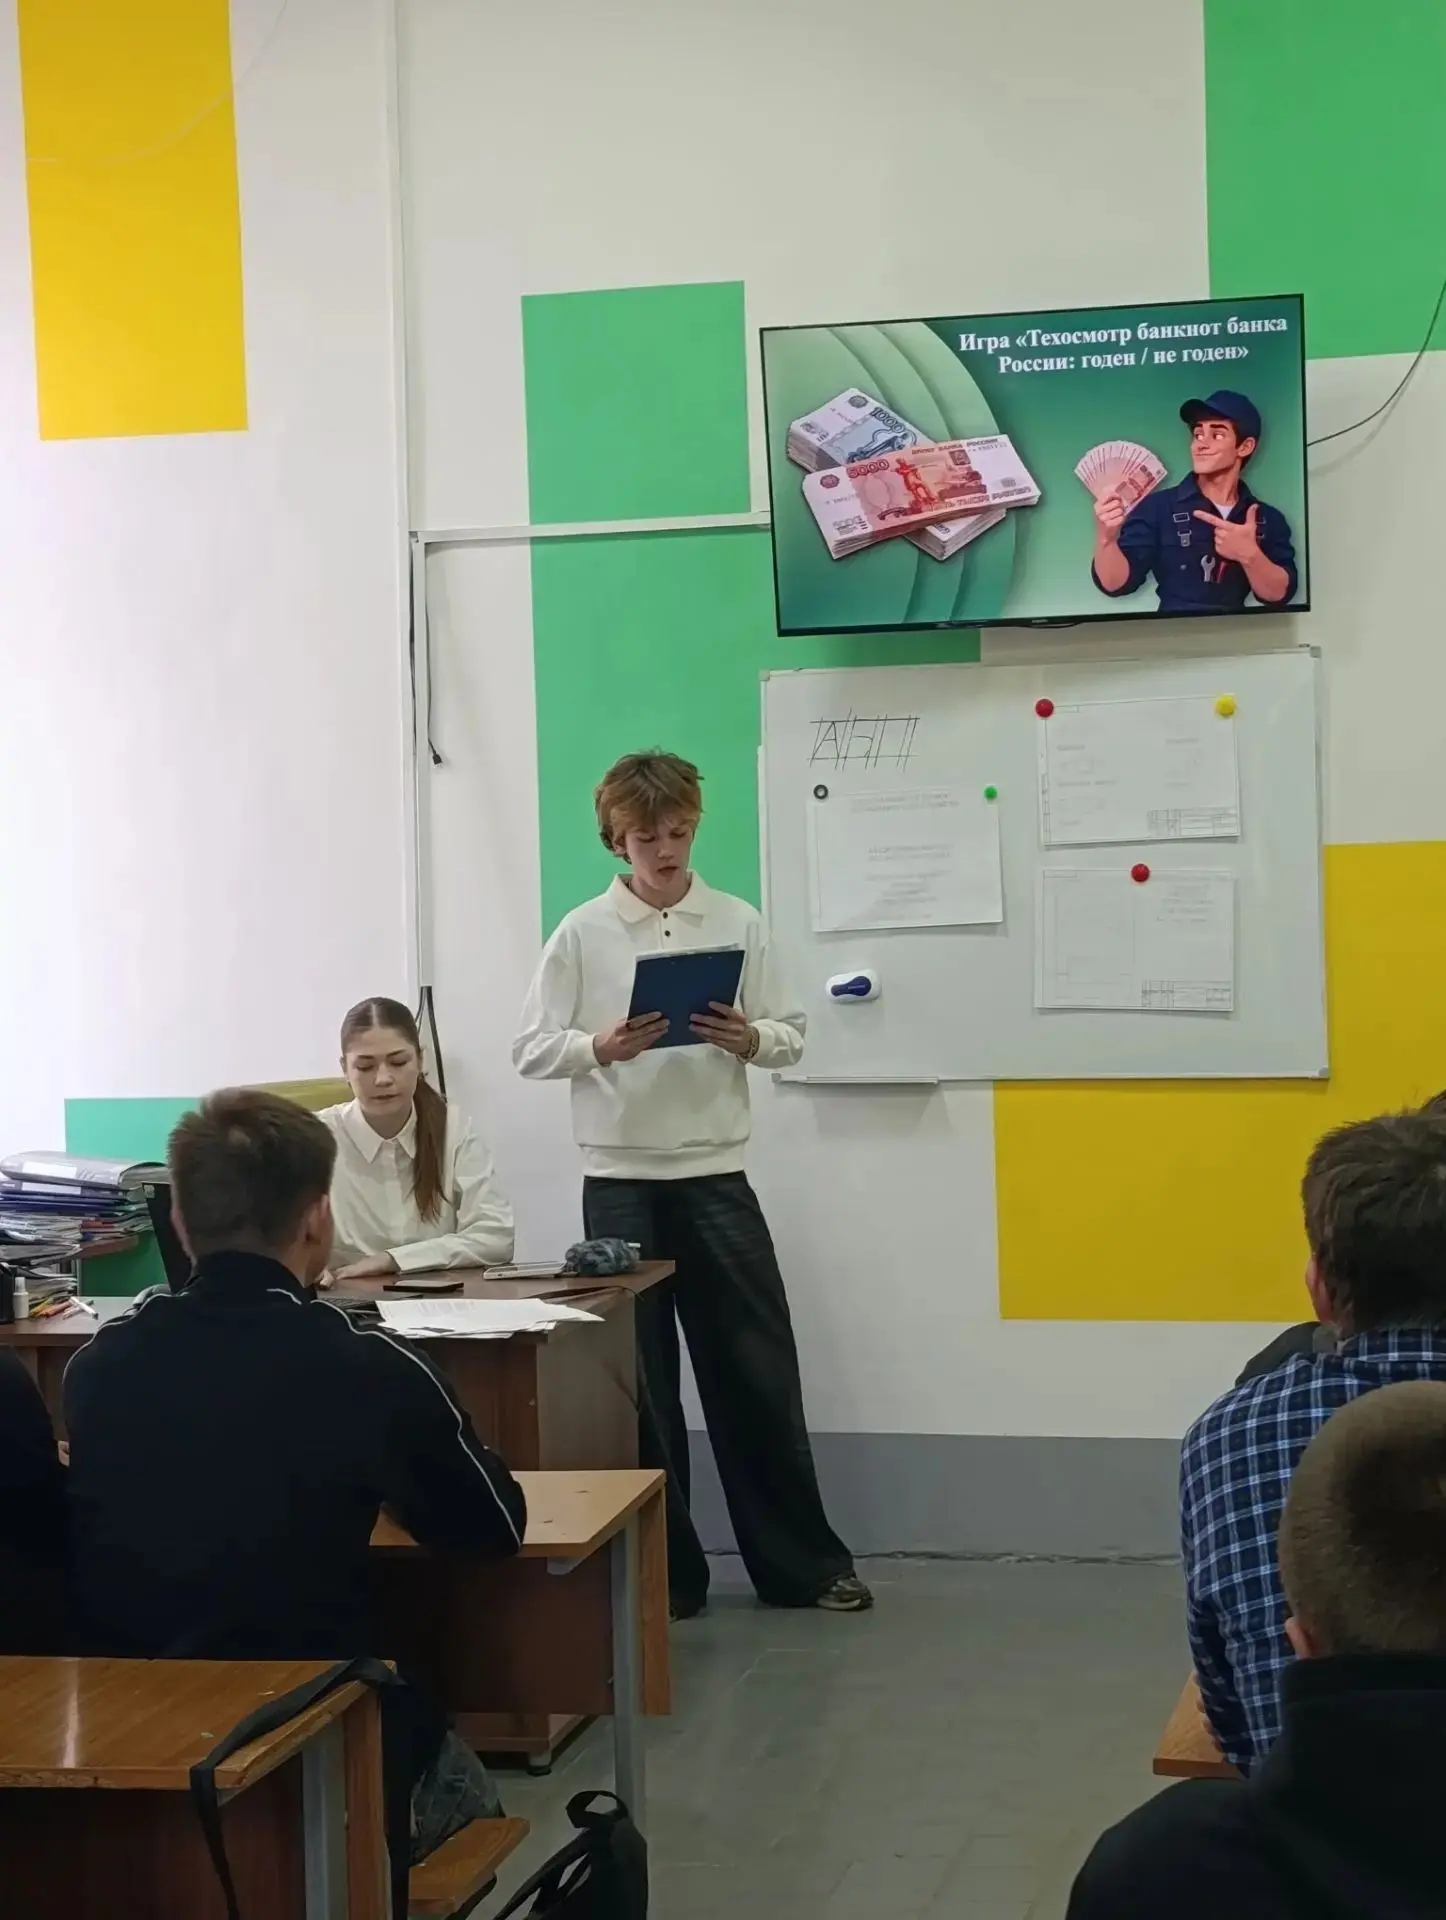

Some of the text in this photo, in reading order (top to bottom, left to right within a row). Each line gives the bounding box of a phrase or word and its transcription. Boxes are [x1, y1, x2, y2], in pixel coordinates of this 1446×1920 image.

[959, 316, 1288, 354] Игра «Техосмотр банкнот банка
[999, 347, 1250, 373] России: годен / не годен»
[870, 406, 906, 434] 1000
[846, 458, 890, 479] 5000
